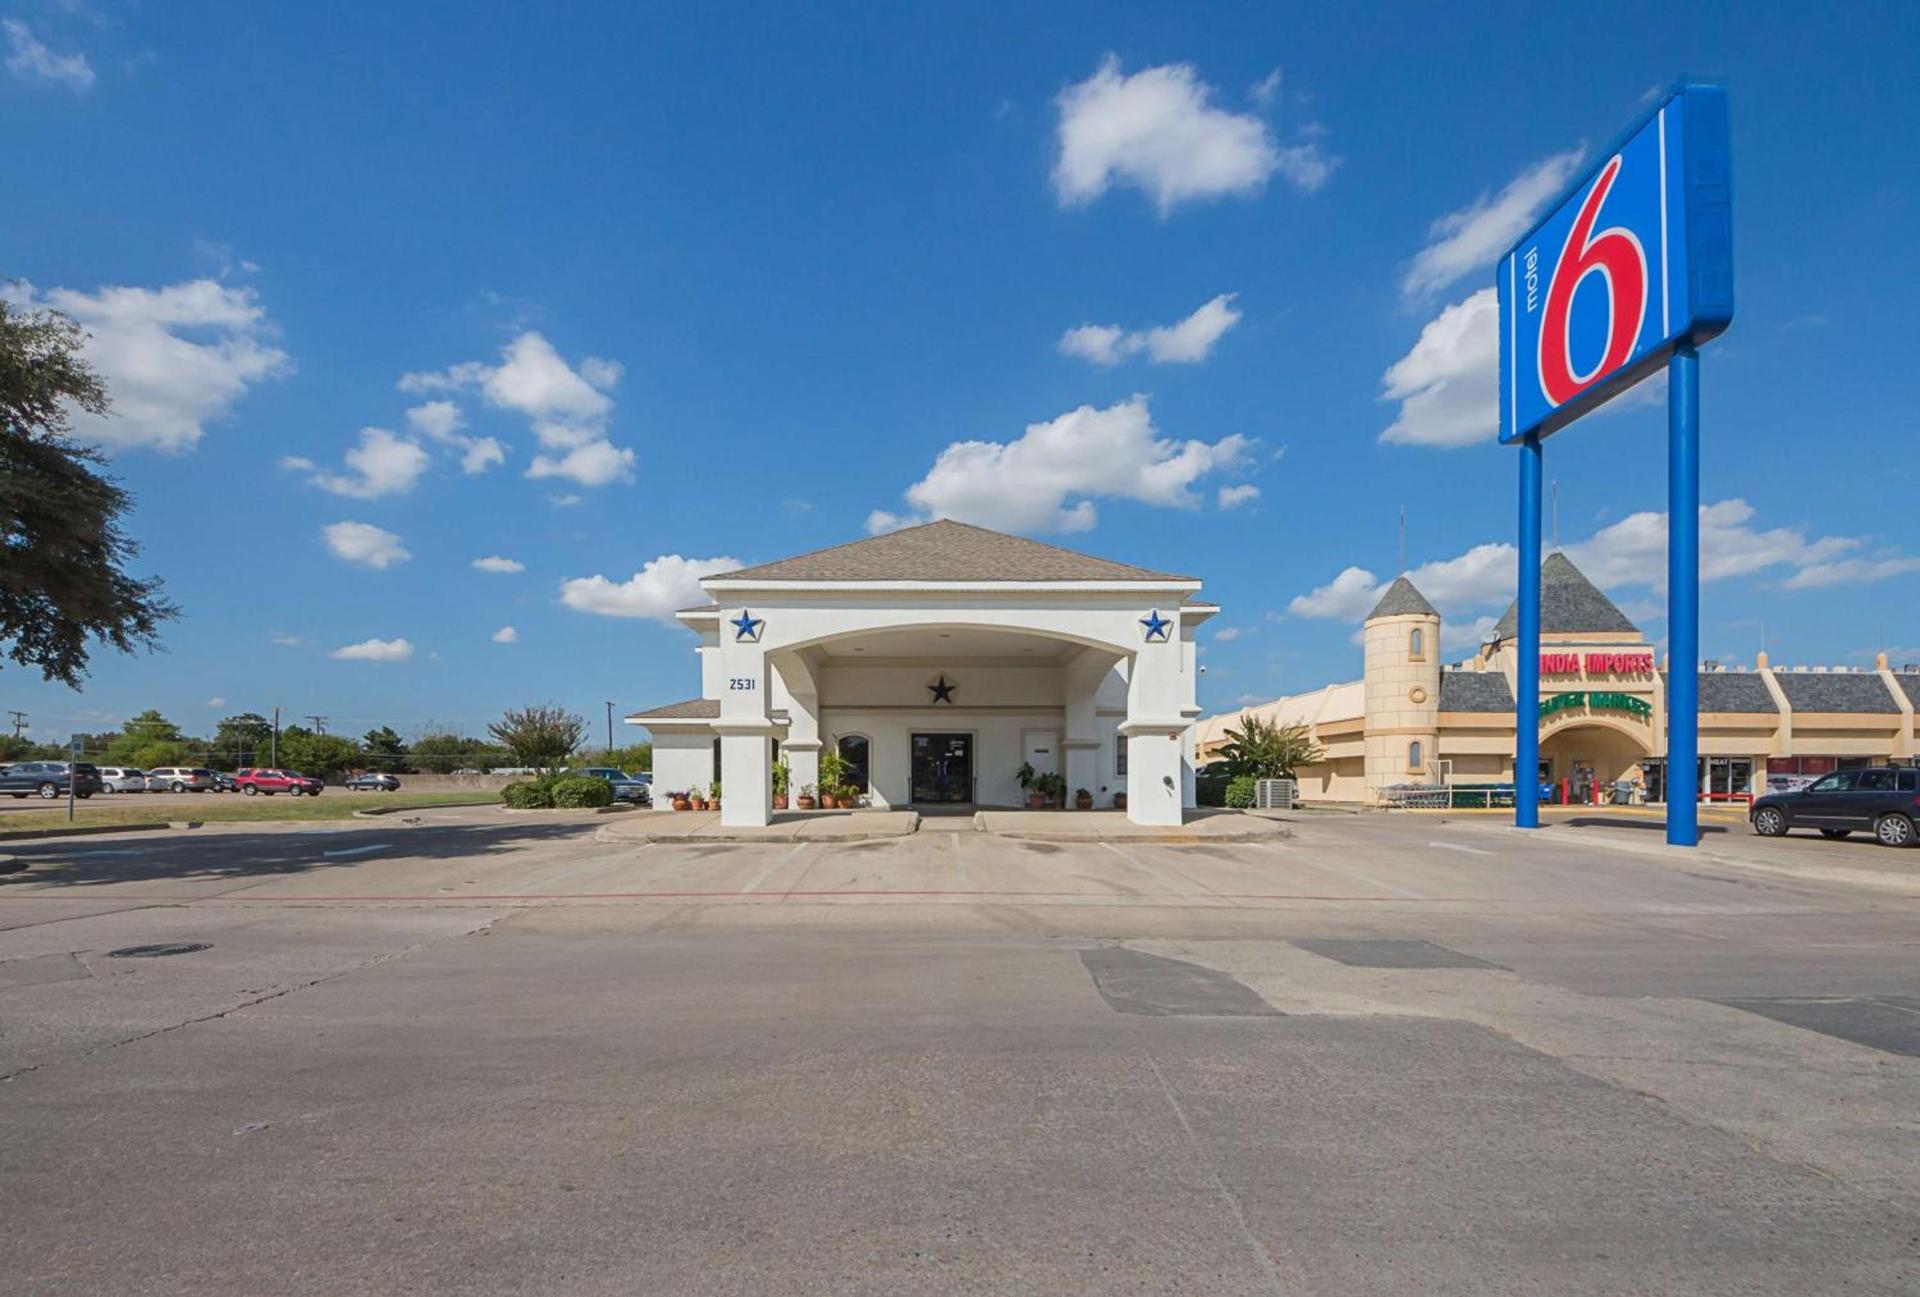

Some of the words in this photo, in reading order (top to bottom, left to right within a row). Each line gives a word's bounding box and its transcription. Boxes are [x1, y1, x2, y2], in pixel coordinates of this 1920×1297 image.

[1523, 246, 1537, 313] motel
[1537, 153, 1648, 408] 6
[1539, 653, 1580, 673] INDIA
[1584, 653, 1652, 673] IMPORTS
[730, 679, 755, 690] 2531
[1589, 691, 1652, 718] MARKET
